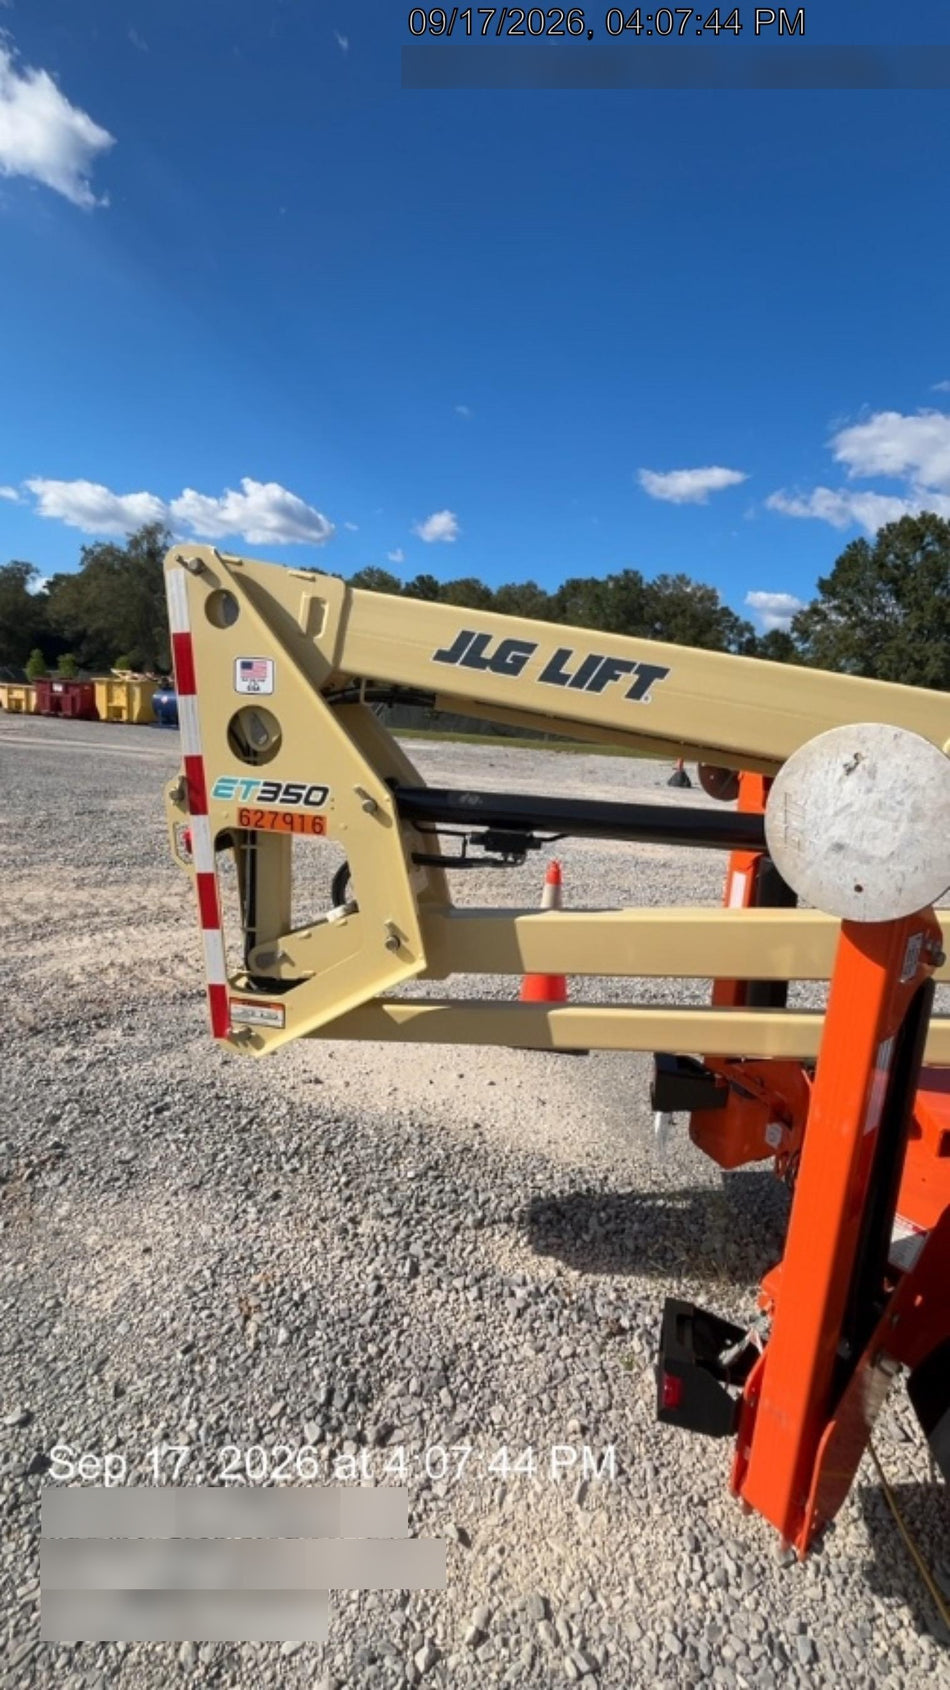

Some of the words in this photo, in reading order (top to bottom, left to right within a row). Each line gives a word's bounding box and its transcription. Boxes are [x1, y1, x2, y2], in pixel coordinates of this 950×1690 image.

[432, 629, 539, 677] JLG
[537, 647, 671, 702] LIFT
[211, 777, 330, 807] ET350
[239, 808, 325, 835] 627916
